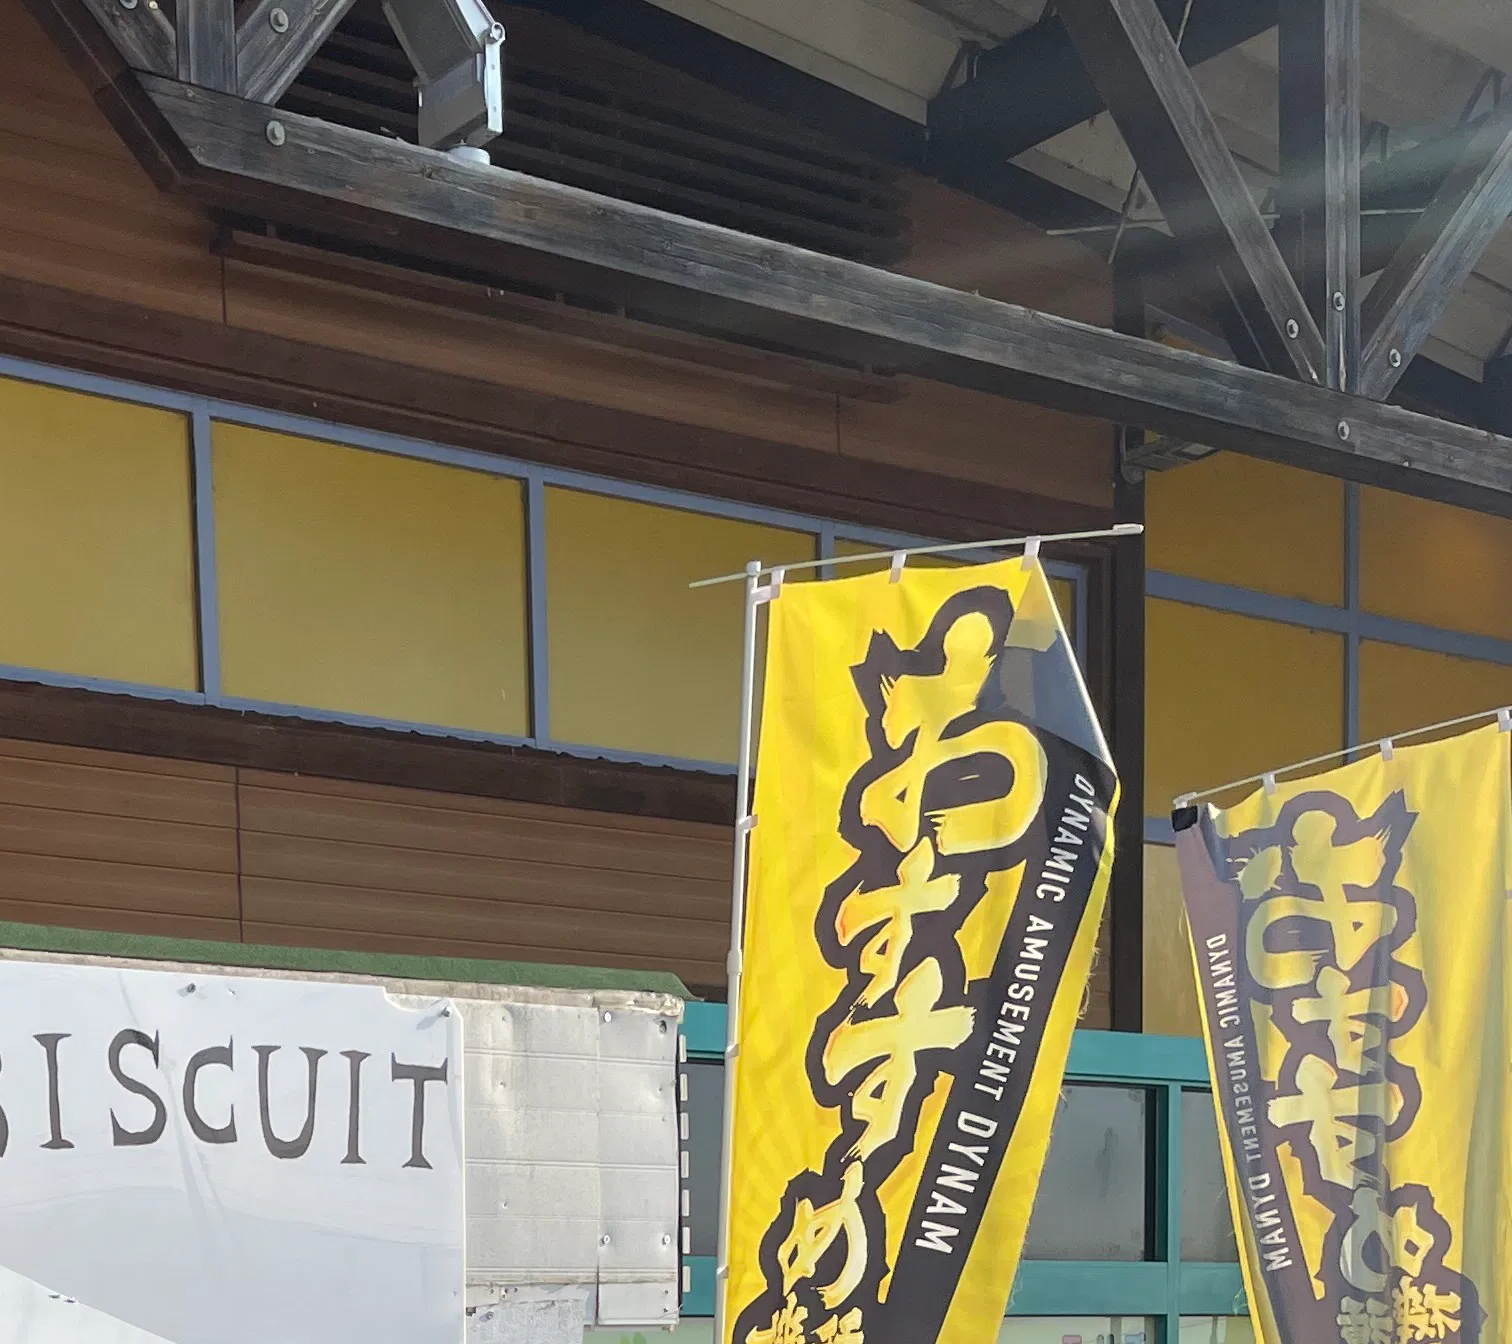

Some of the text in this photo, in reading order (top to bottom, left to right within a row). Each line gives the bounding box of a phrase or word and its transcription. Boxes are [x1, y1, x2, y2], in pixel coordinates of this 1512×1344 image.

[914, 773, 1095, 1255] DYNAMIC AMUSEMENT DYNAM
